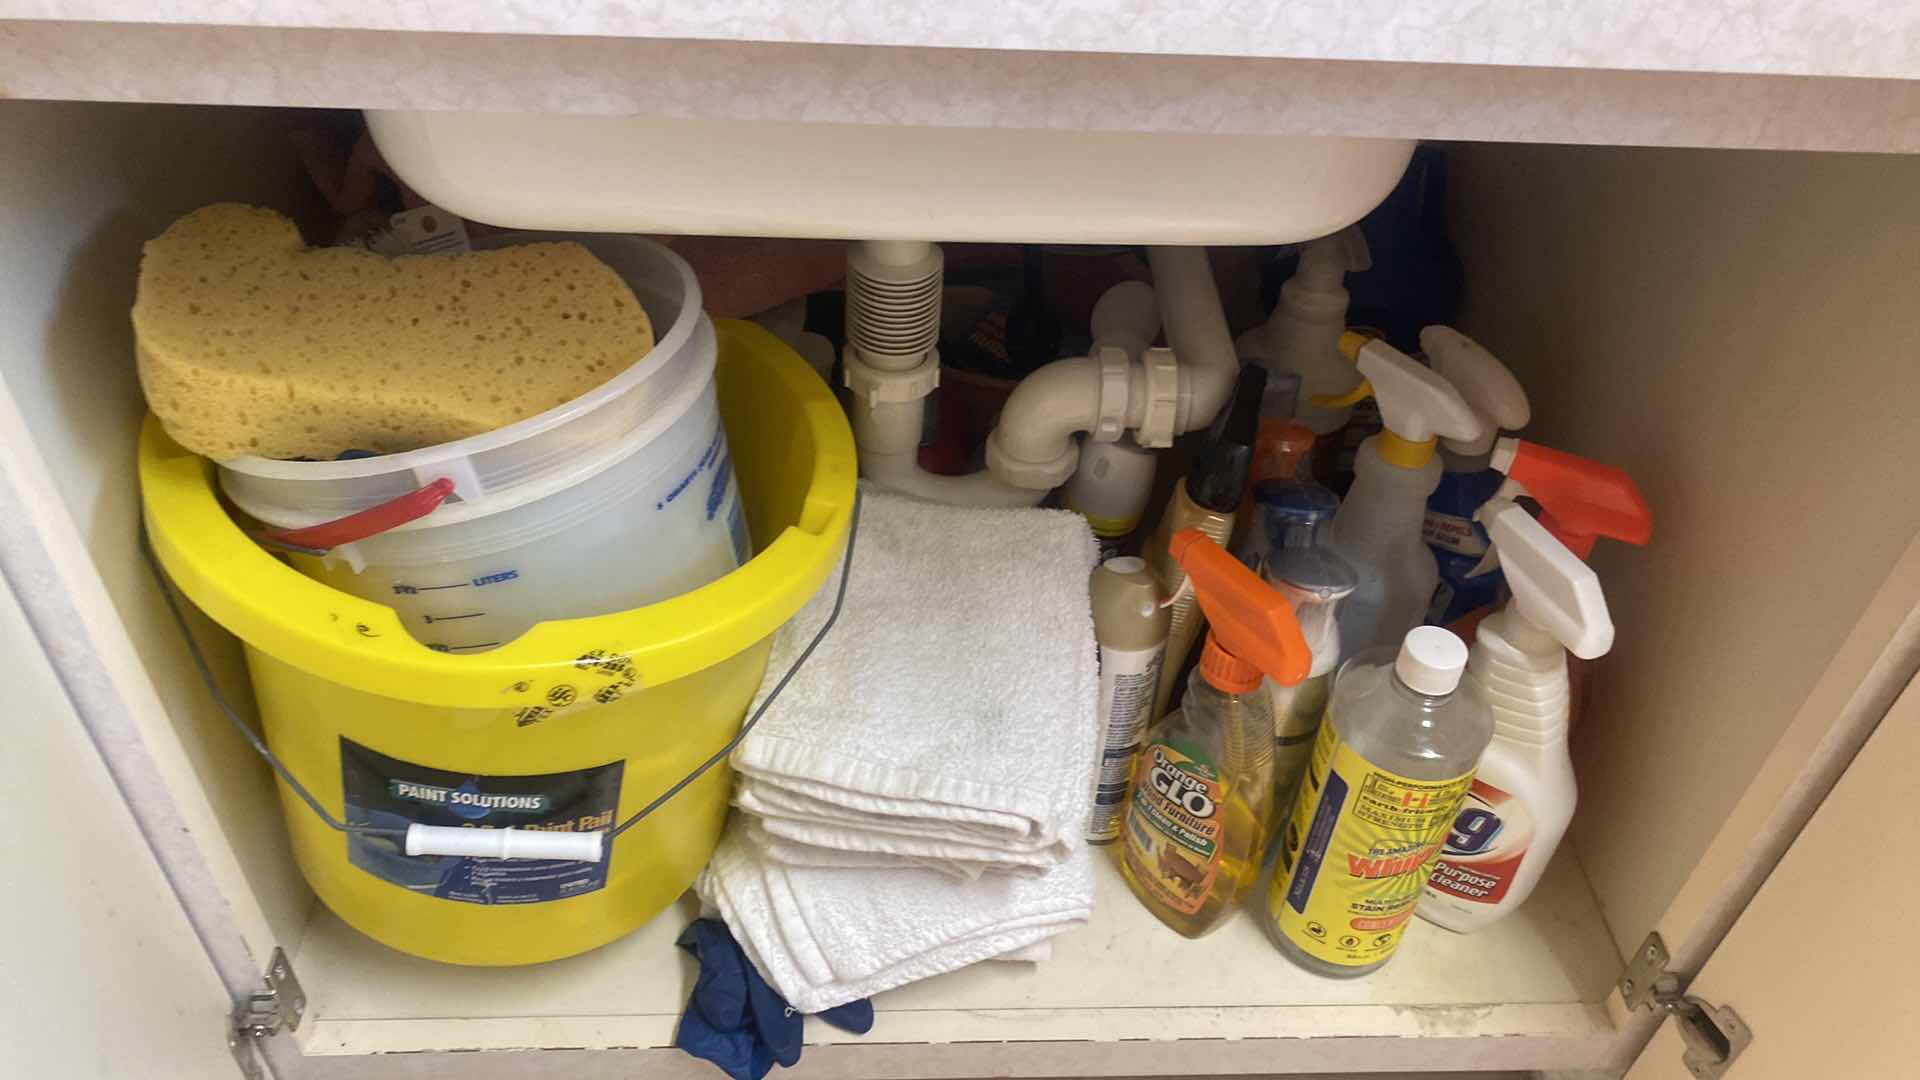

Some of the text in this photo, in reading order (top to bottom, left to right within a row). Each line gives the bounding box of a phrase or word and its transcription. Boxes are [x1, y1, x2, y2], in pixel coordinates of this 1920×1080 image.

[472, 570, 519, 587] LITERS
[1153, 749, 1208, 794] Orange
[399, 784, 543, 809] PAINT SOLUTIONS
[1151, 767, 1216, 818] GLO
[579, 809, 614, 832] Pail
[1163, 802, 1216, 835] Furniture
[1430, 872, 1489, 897] Cleaner
[1434, 862, 1497, 889] Purpose
